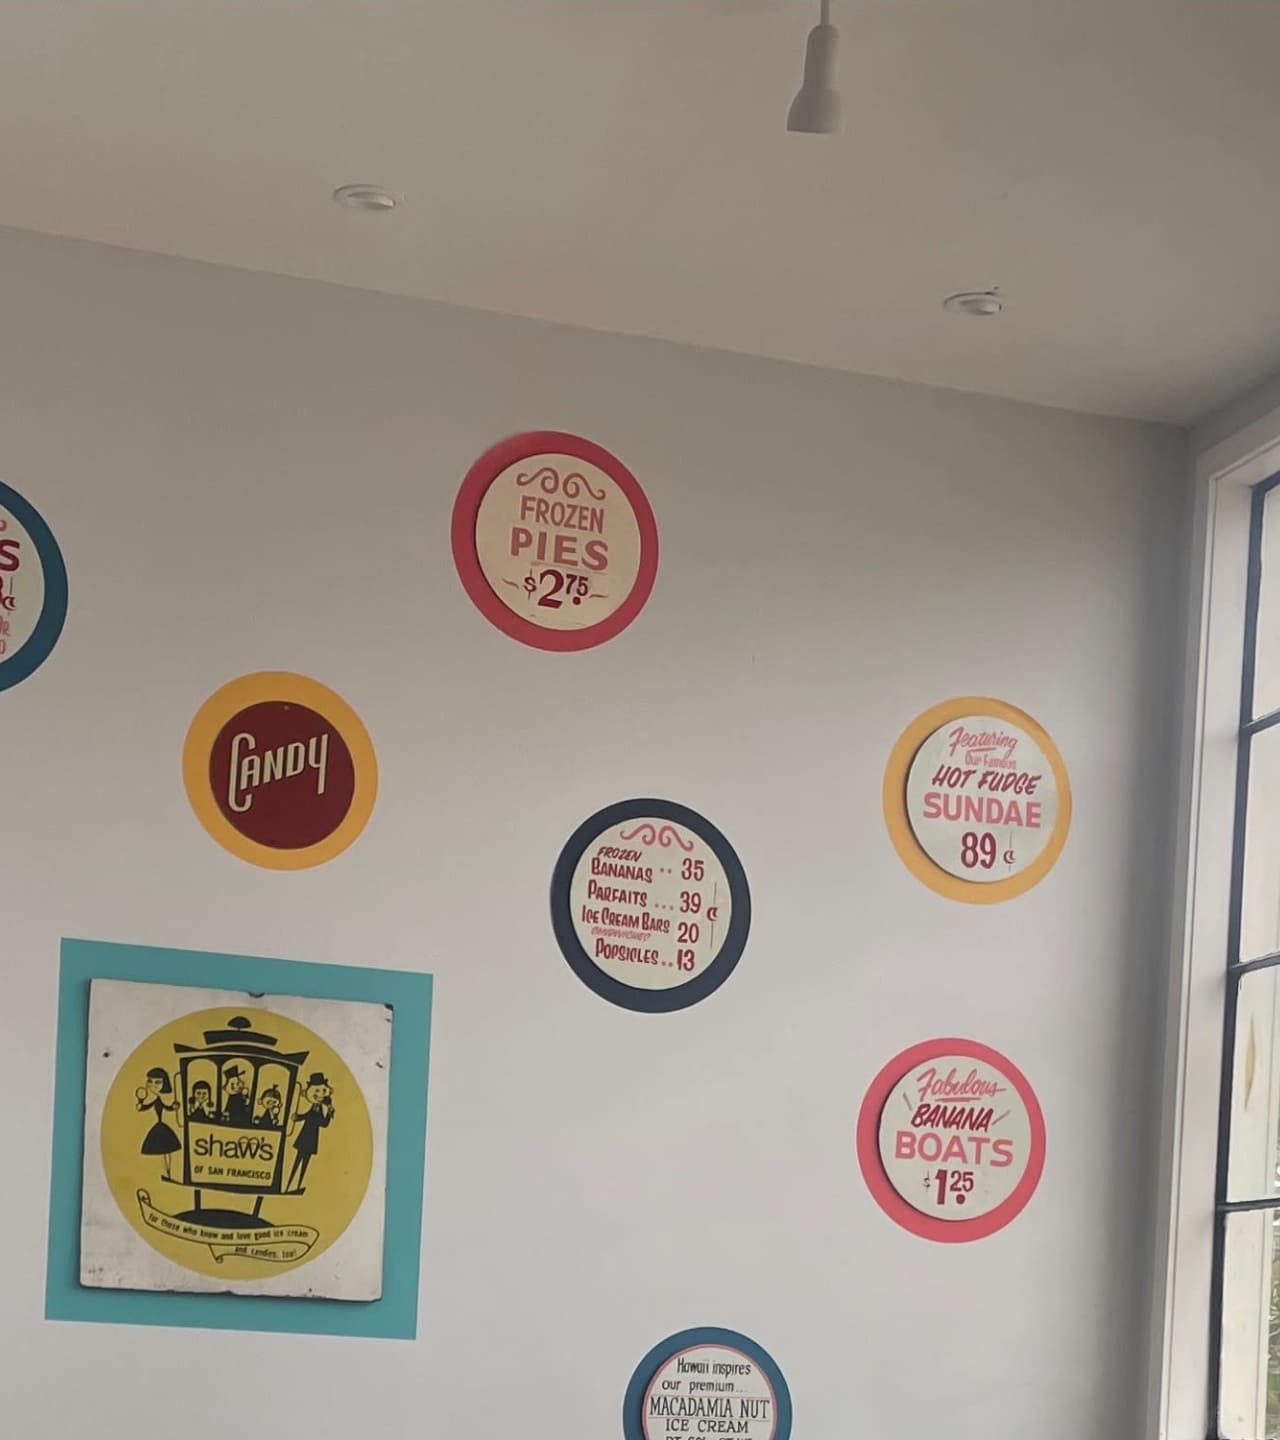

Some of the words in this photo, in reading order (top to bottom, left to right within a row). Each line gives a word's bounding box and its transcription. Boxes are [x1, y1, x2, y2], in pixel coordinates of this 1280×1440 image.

[520, 495, 605, 534] FROZEN
[510, 527, 609, 571] PIES
[949, 727, 1018, 758] Featuring
[931, 764, 977, 789] HOT
[978, 771, 1042, 794] FUDGE
[923, 792, 1041, 828] SUNDAE
[597, 846, 642, 862] FROZEN
[591, 858, 653, 883] BANANAS
[681, 858, 705, 882] 35
[587, 879, 648, 907] PARFAITS
[679, 891, 701, 914] 39
[582, 905, 599, 924] ICE
[601, 908, 640, 929] CREAM
[642, 912, 670, 934] BARS
[677, 923, 700, 944] 20
[595, 938, 659, 966] POPSICLES
[677, 949, 695, 971] 13
[917, 1067, 1006, 1102] Fabulous
[910, 1104, 994, 1132] BANANA
[895, 1130, 1014, 1168] BOATS
[208, 1166, 223, 1175] SAN
[227, 1168, 271, 1180] FRANCISCO
[677, 1357, 709, 1375] Hawaii
[712, 1360, 751, 1378] inspires
[662, 1380, 681, 1390] our
[650, 1397, 734, 1418] MACADAMIA
[740, 1399, 770, 1419] NUT
[666, 1419, 689, 1432] ICE
[698, 1420, 749, 1433] CREAM
